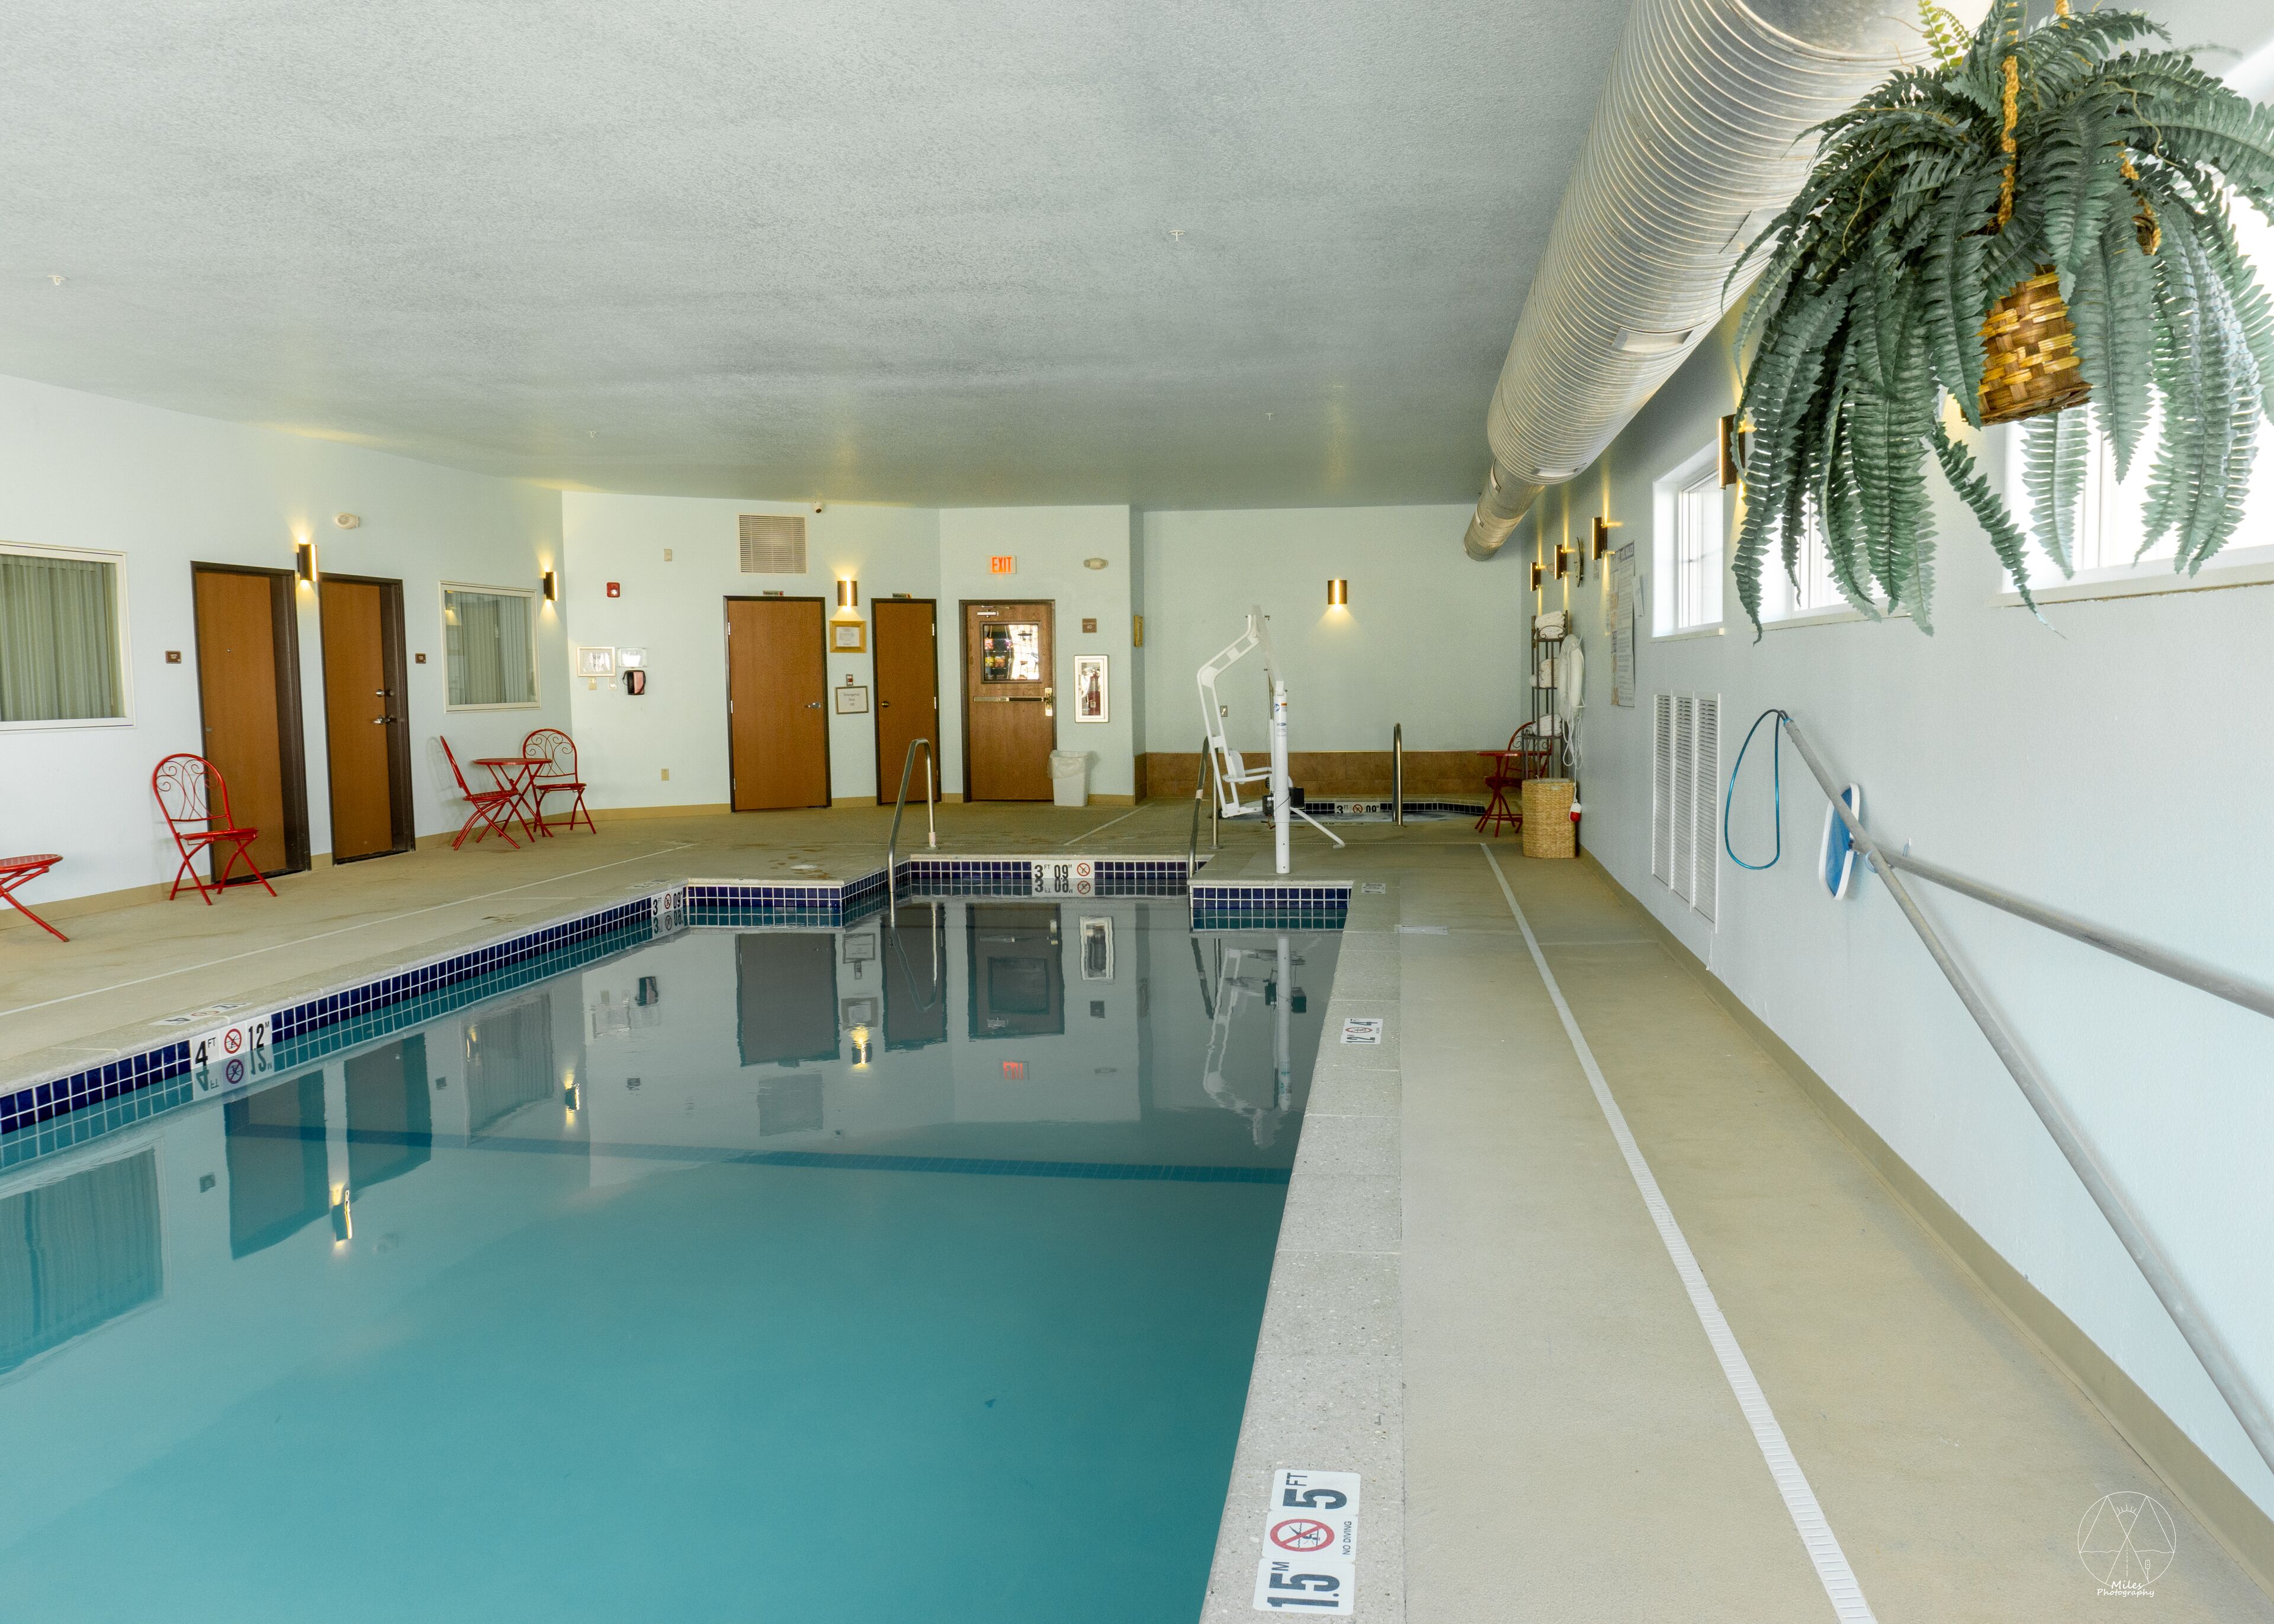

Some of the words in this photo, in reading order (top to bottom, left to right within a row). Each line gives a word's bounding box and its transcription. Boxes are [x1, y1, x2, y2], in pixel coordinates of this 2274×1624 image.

[992, 557, 1012, 573] EXIT
[1034, 864, 1043, 879] 3
[653, 899, 658, 915] 3
[195, 1040, 208, 1066] 4
[208, 1037, 216, 1048] FT
[1286, 1472, 1308, 1486] FT
[1282, 1488, 1347, 1510] 5
[1344, 1521, 1352, 1540] DIVING
[1342, 1541, 1351, 1555] NO
[1271, 1561, 1290, 1571] M
[1267, 1572, 1340, 1607] 1.5
